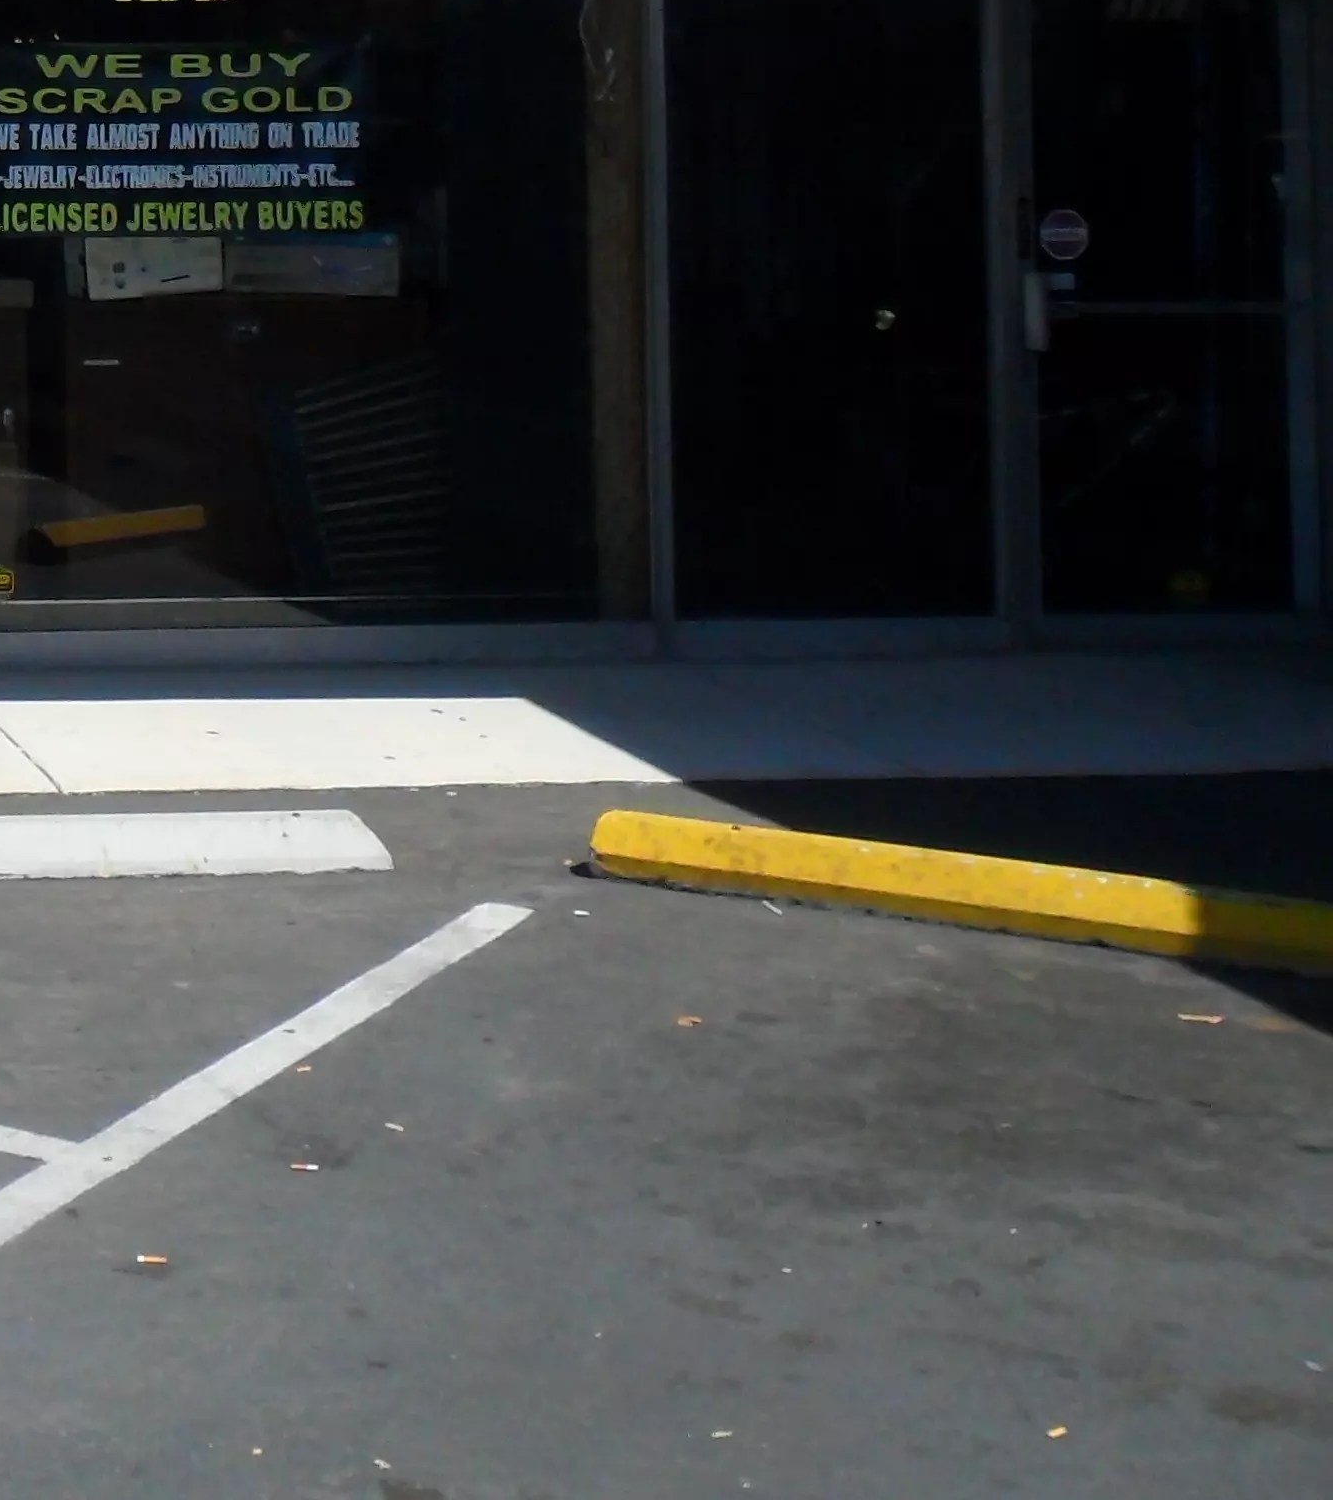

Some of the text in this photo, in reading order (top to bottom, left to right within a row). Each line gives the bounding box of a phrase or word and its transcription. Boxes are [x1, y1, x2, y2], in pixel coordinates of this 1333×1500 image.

[35, 52, 311, 79] WE BUY
[201, 86, 353, 114] GOLD
[29, 123, 77, 150] TAKE
[86, 122, 160, 150] ALMOST
[169, 122, 259, 149] ANYTHING
[302, 121, 360, 149] TRADE
[126, 201, 248, 231] JEWELRY
[258, 200, 364, 231] BUYERS
